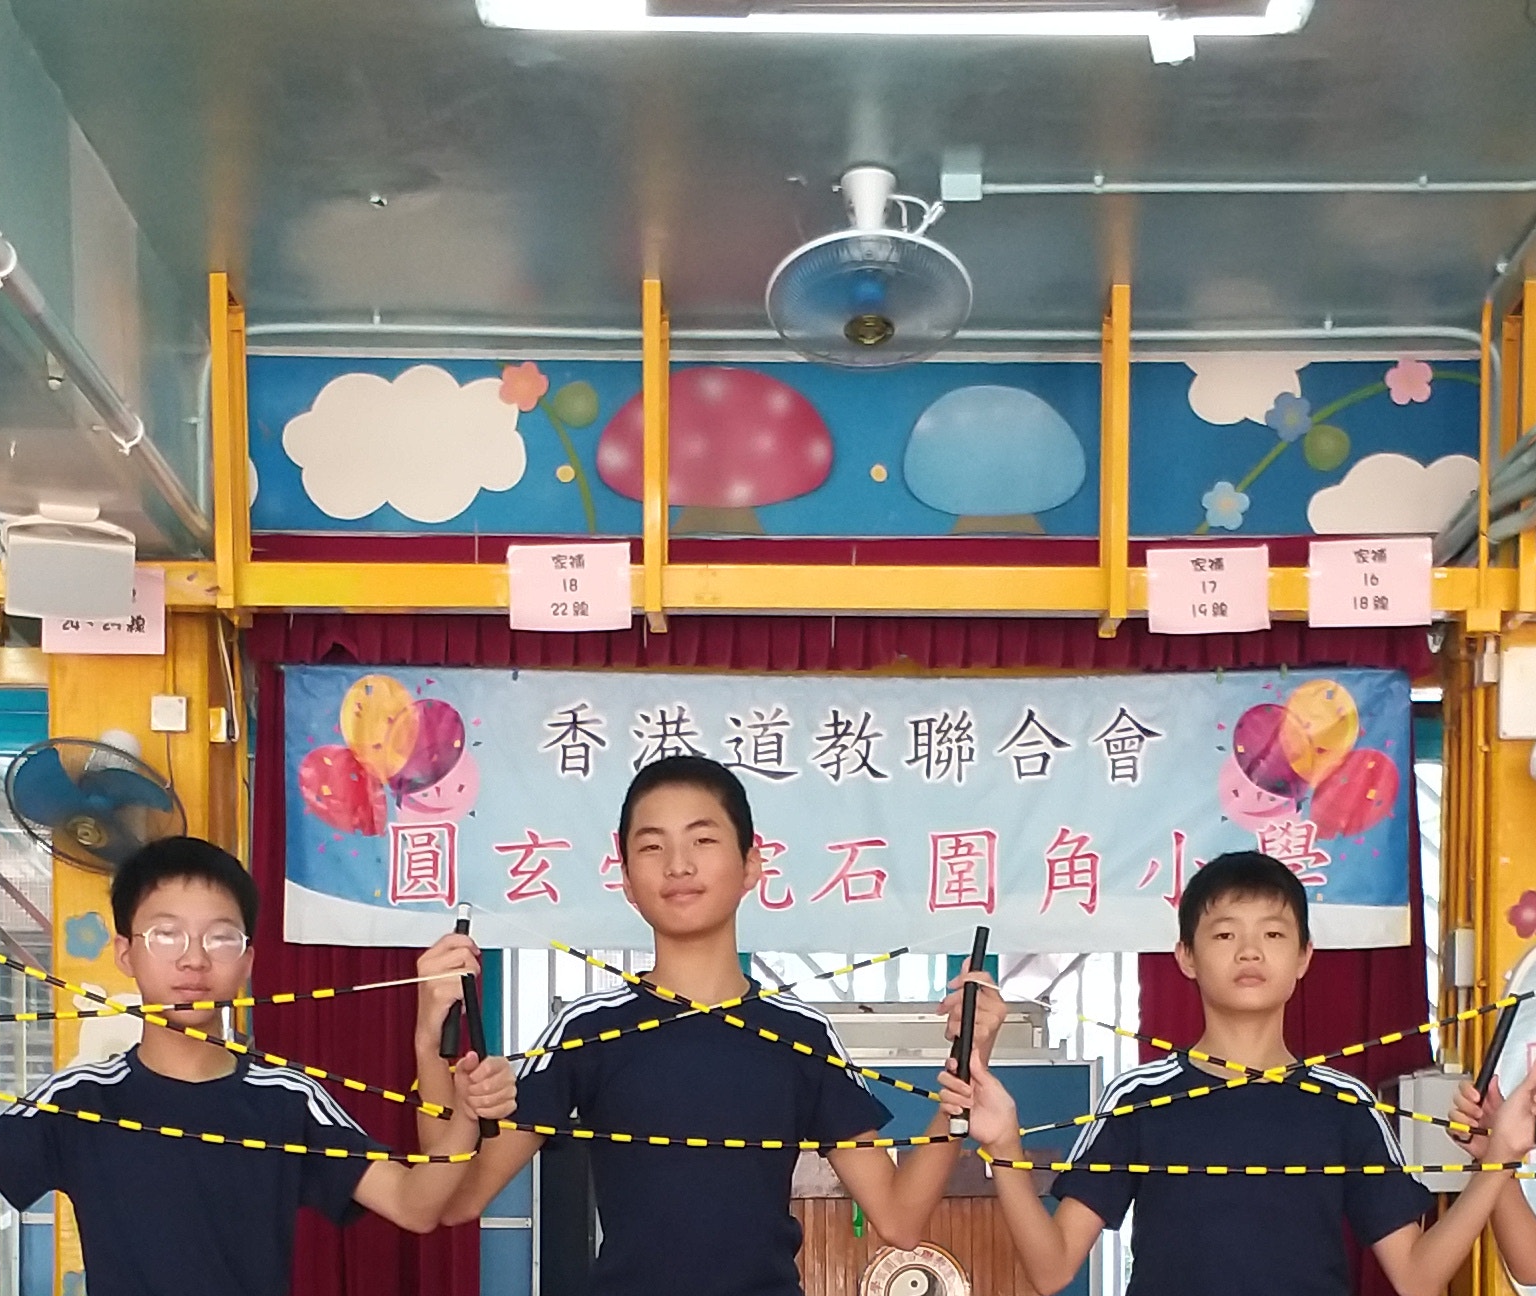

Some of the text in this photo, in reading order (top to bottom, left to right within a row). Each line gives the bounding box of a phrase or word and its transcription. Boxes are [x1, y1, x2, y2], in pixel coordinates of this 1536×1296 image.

[562, 577, 578, 593] 18
[1201, 580, 1218, 594] 17
[1363, 572, 1380, 587] 16
[543, 702, 1163, 785] 香港道教聯合會
